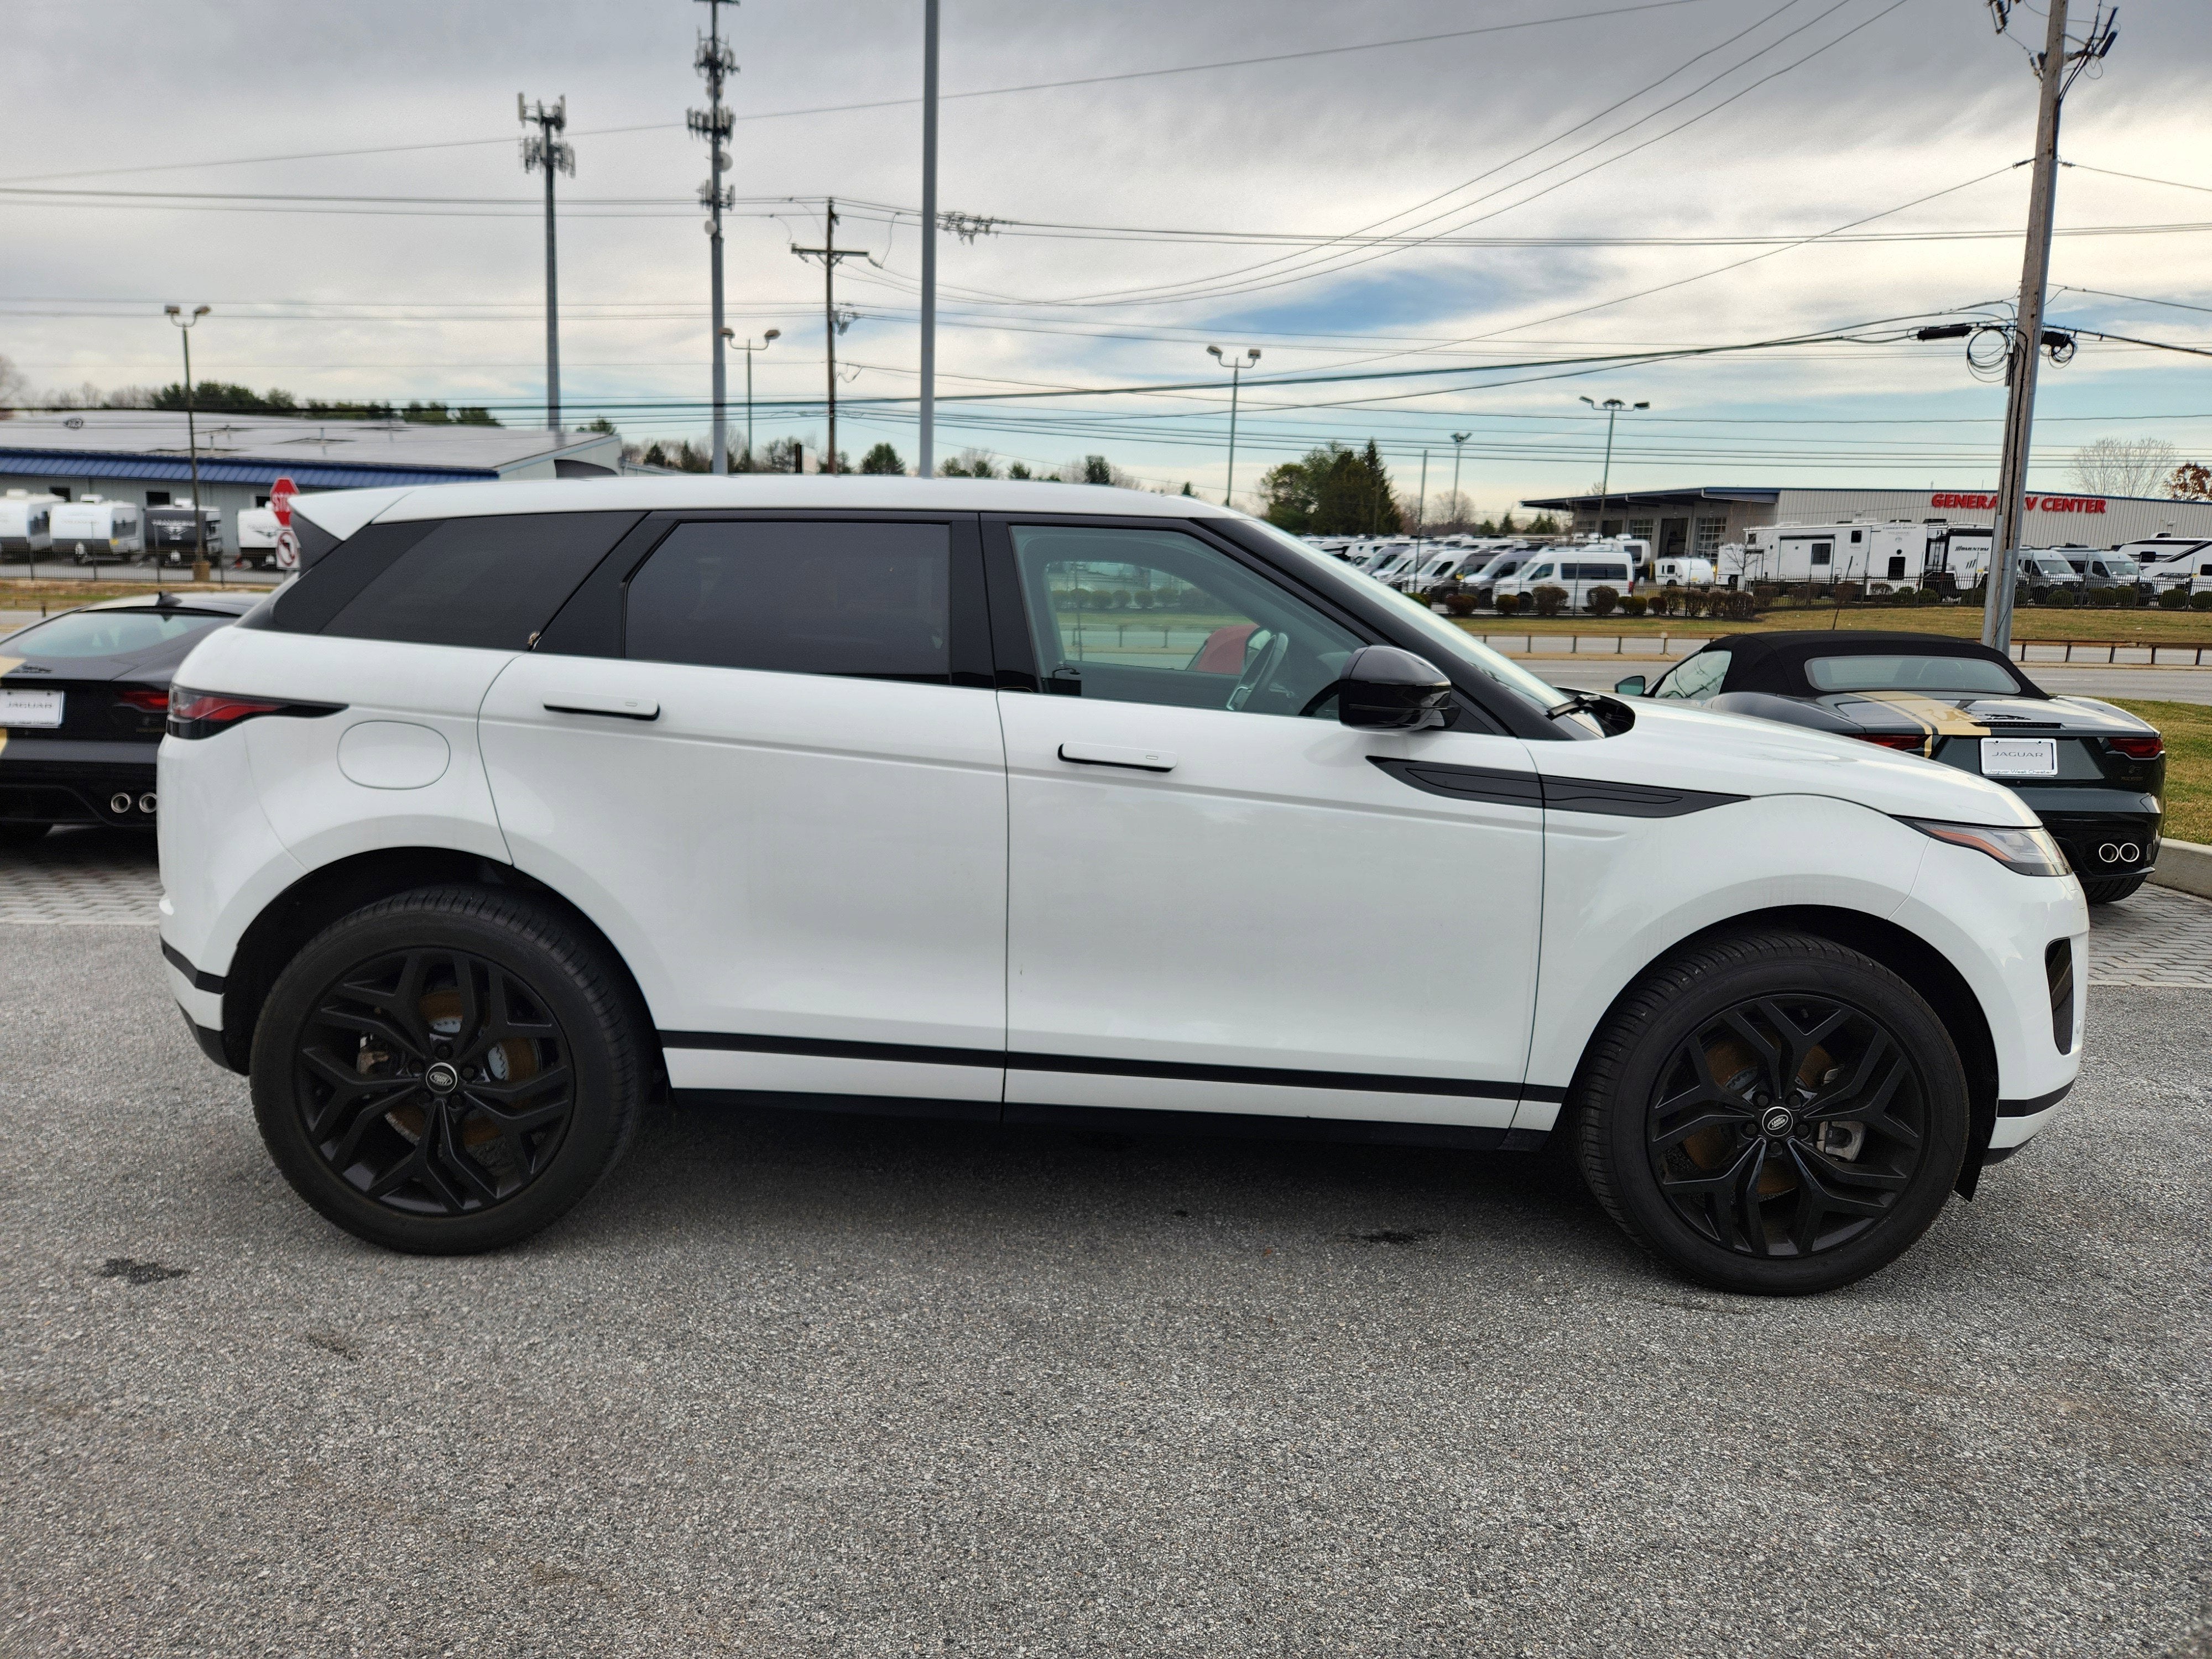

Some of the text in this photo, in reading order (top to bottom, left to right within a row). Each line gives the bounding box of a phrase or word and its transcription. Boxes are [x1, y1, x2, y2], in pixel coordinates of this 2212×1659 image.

[1932, 494, 1998, 510] GENERA
[2041, 498, 2107, 514] CENTER
[6, 701, 53, 709] JAGUAR
